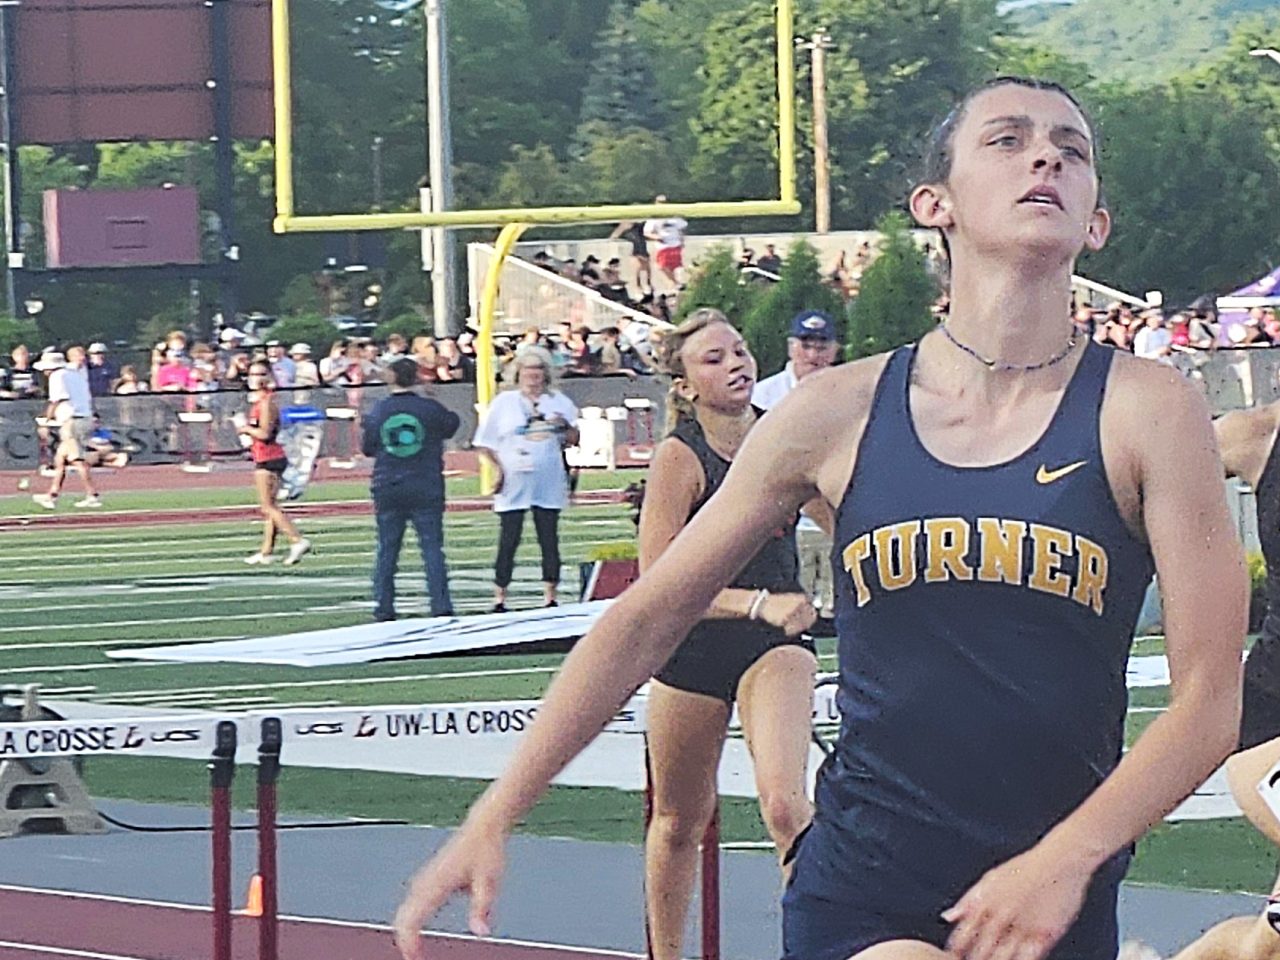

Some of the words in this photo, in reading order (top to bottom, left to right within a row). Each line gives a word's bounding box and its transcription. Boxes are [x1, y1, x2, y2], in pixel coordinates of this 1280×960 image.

[842, 517, 1109, 616] TURNER
[386, 711, 459, 738] UW-LA
[26, 727, 117, 753] CROSSE
